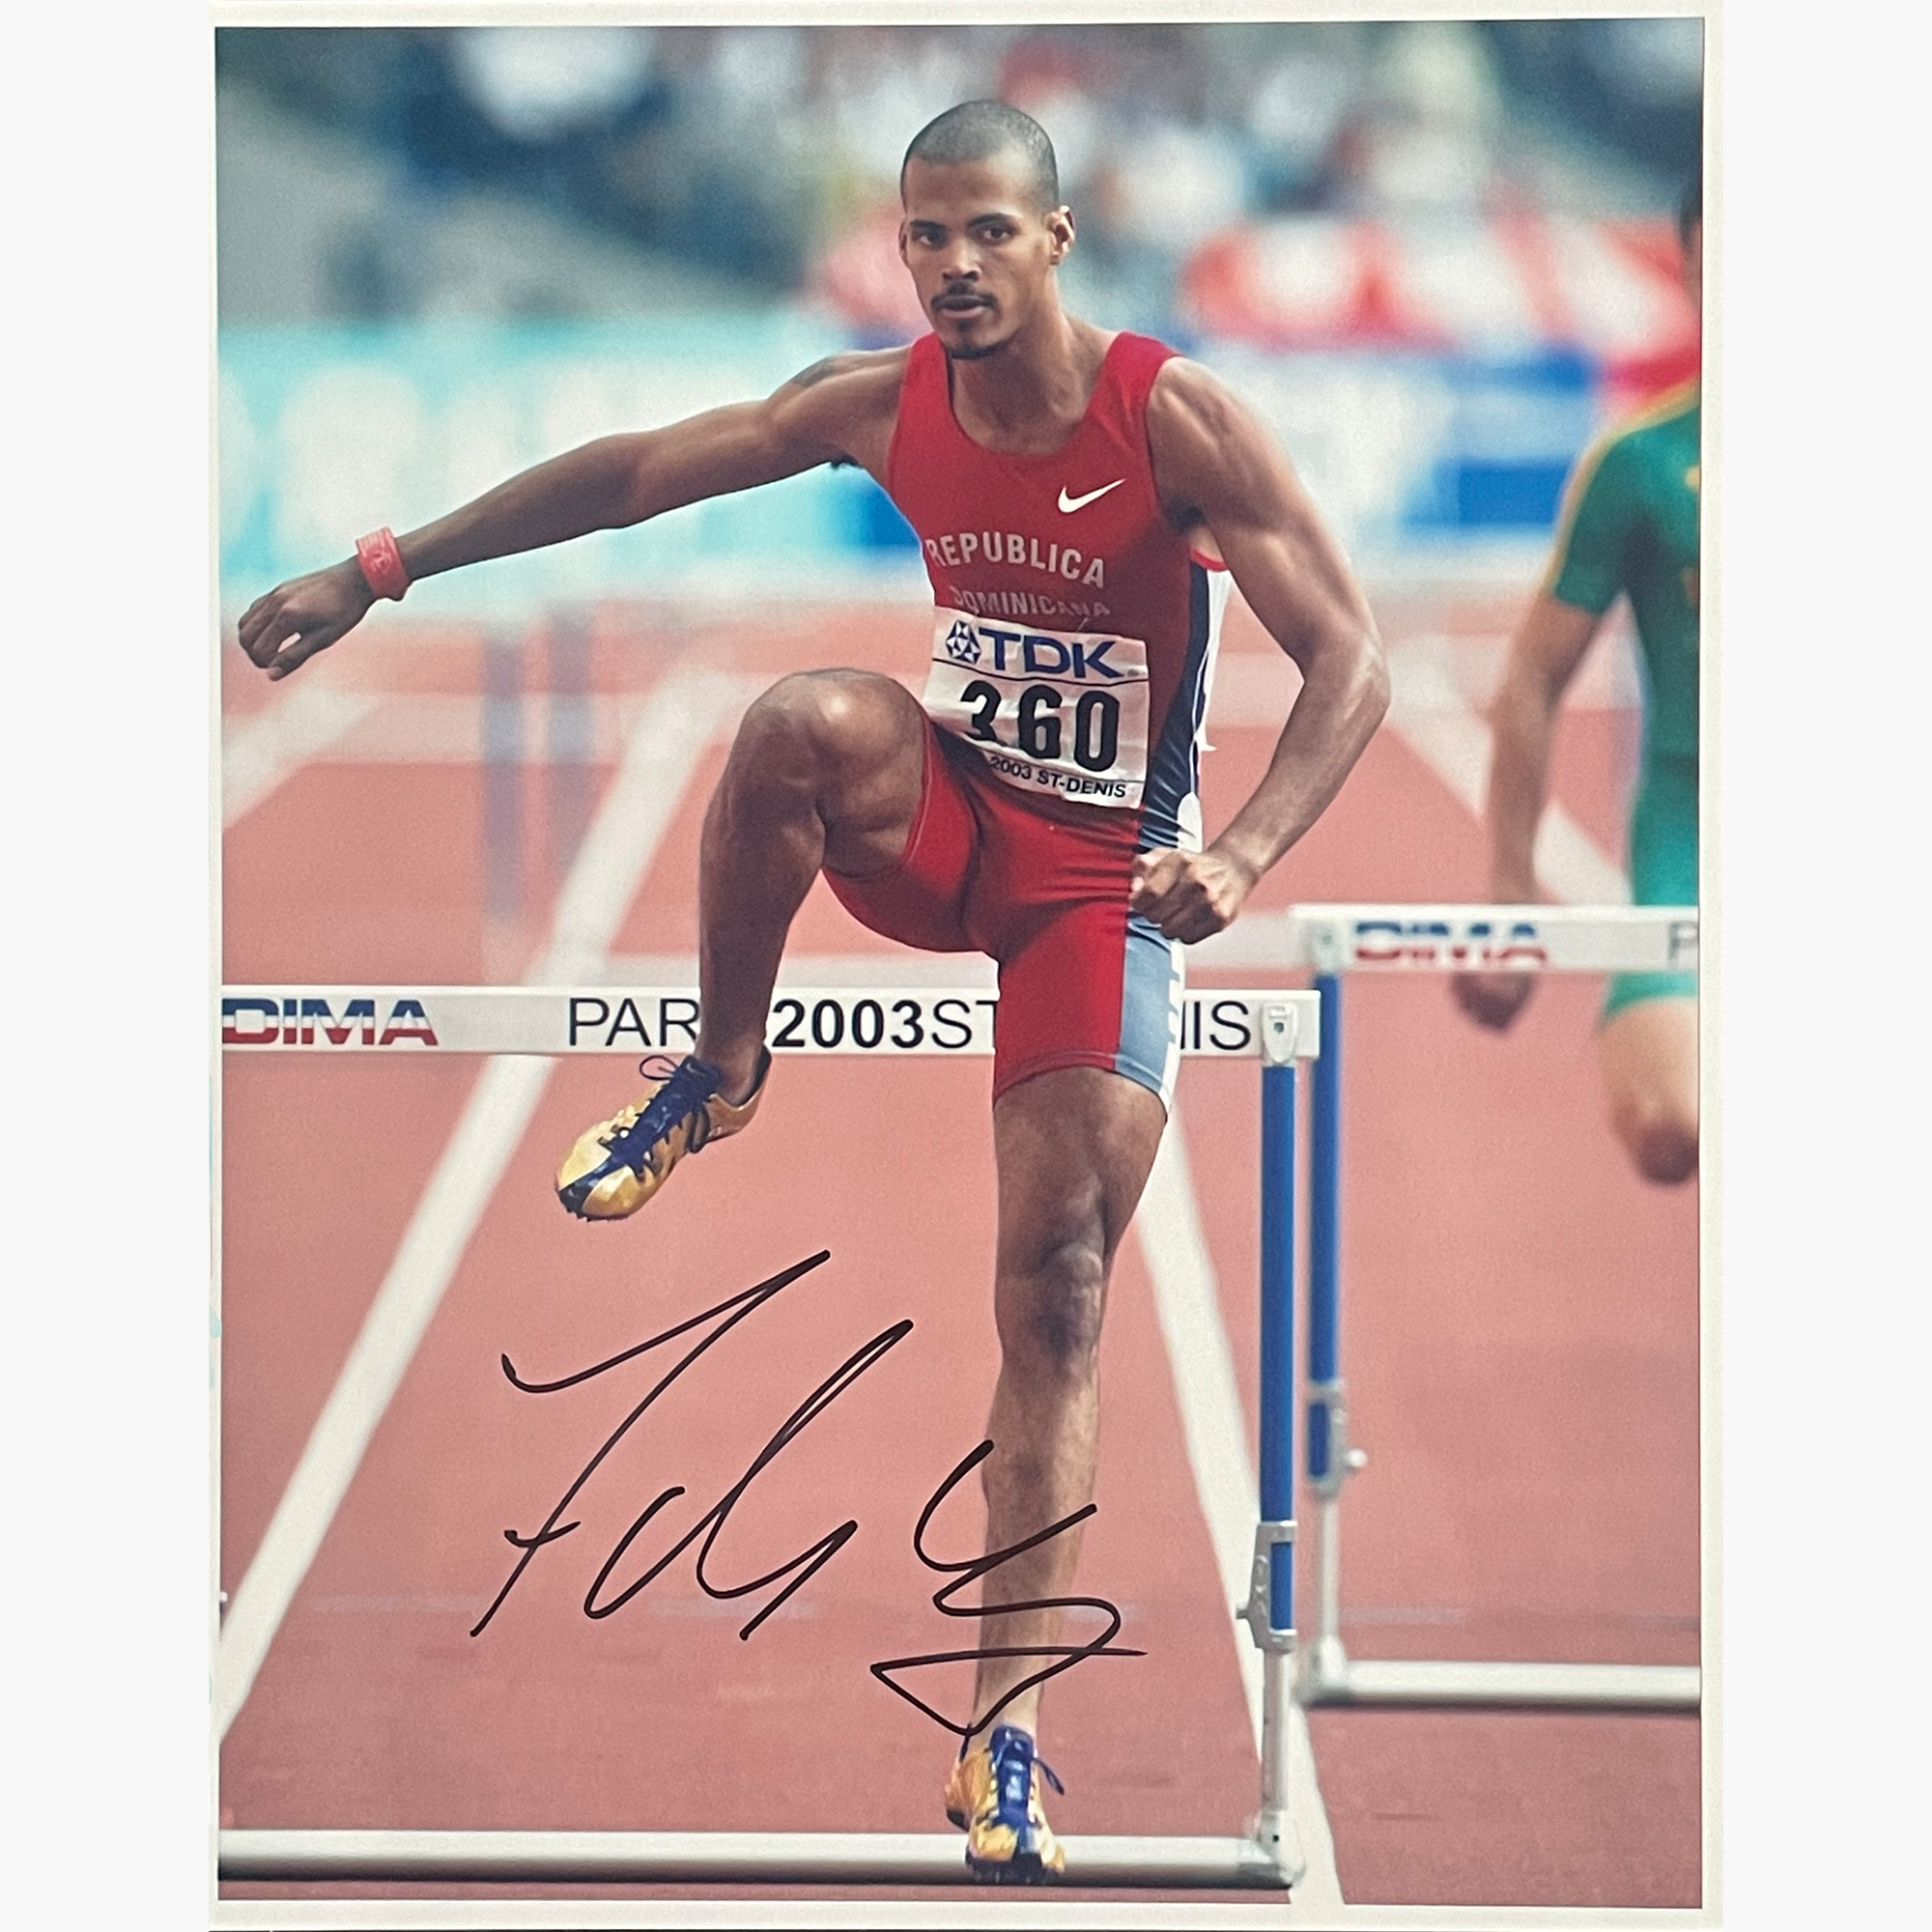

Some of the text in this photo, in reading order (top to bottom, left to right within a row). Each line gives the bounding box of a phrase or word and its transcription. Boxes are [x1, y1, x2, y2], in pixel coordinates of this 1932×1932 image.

[925, 531, 1105, 588] REPUBLICA
[950, 585, 1111, 616] DOMINICANA
[980, 628, 1124, 678] TDK
[960, 679, 1121, 772] 360
[989, 755, 1126, 798] 2003 ST-DENIS
[221, 997, 439, 1045] DIMA
[568, 998, 700, 1046] PAR
